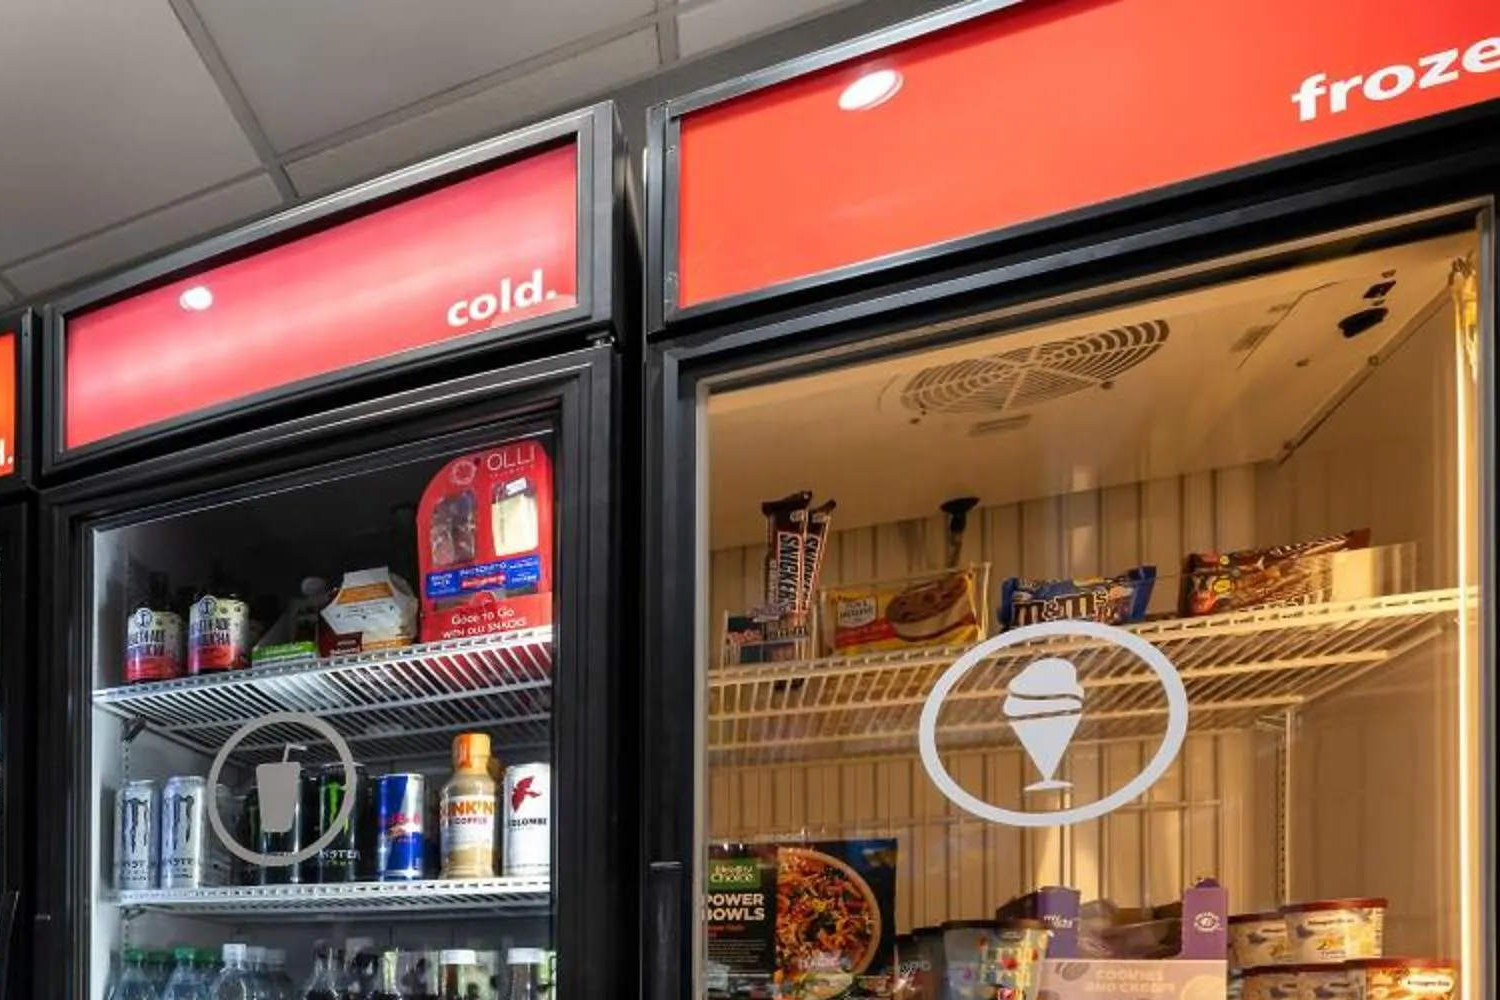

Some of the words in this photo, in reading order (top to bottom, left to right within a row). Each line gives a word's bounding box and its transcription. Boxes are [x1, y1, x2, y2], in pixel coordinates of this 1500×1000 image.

[1290, 36, 1500, 122] froze
[446, 269, 556, 327] cold.
[487, 446, 535, 471] OLLI
